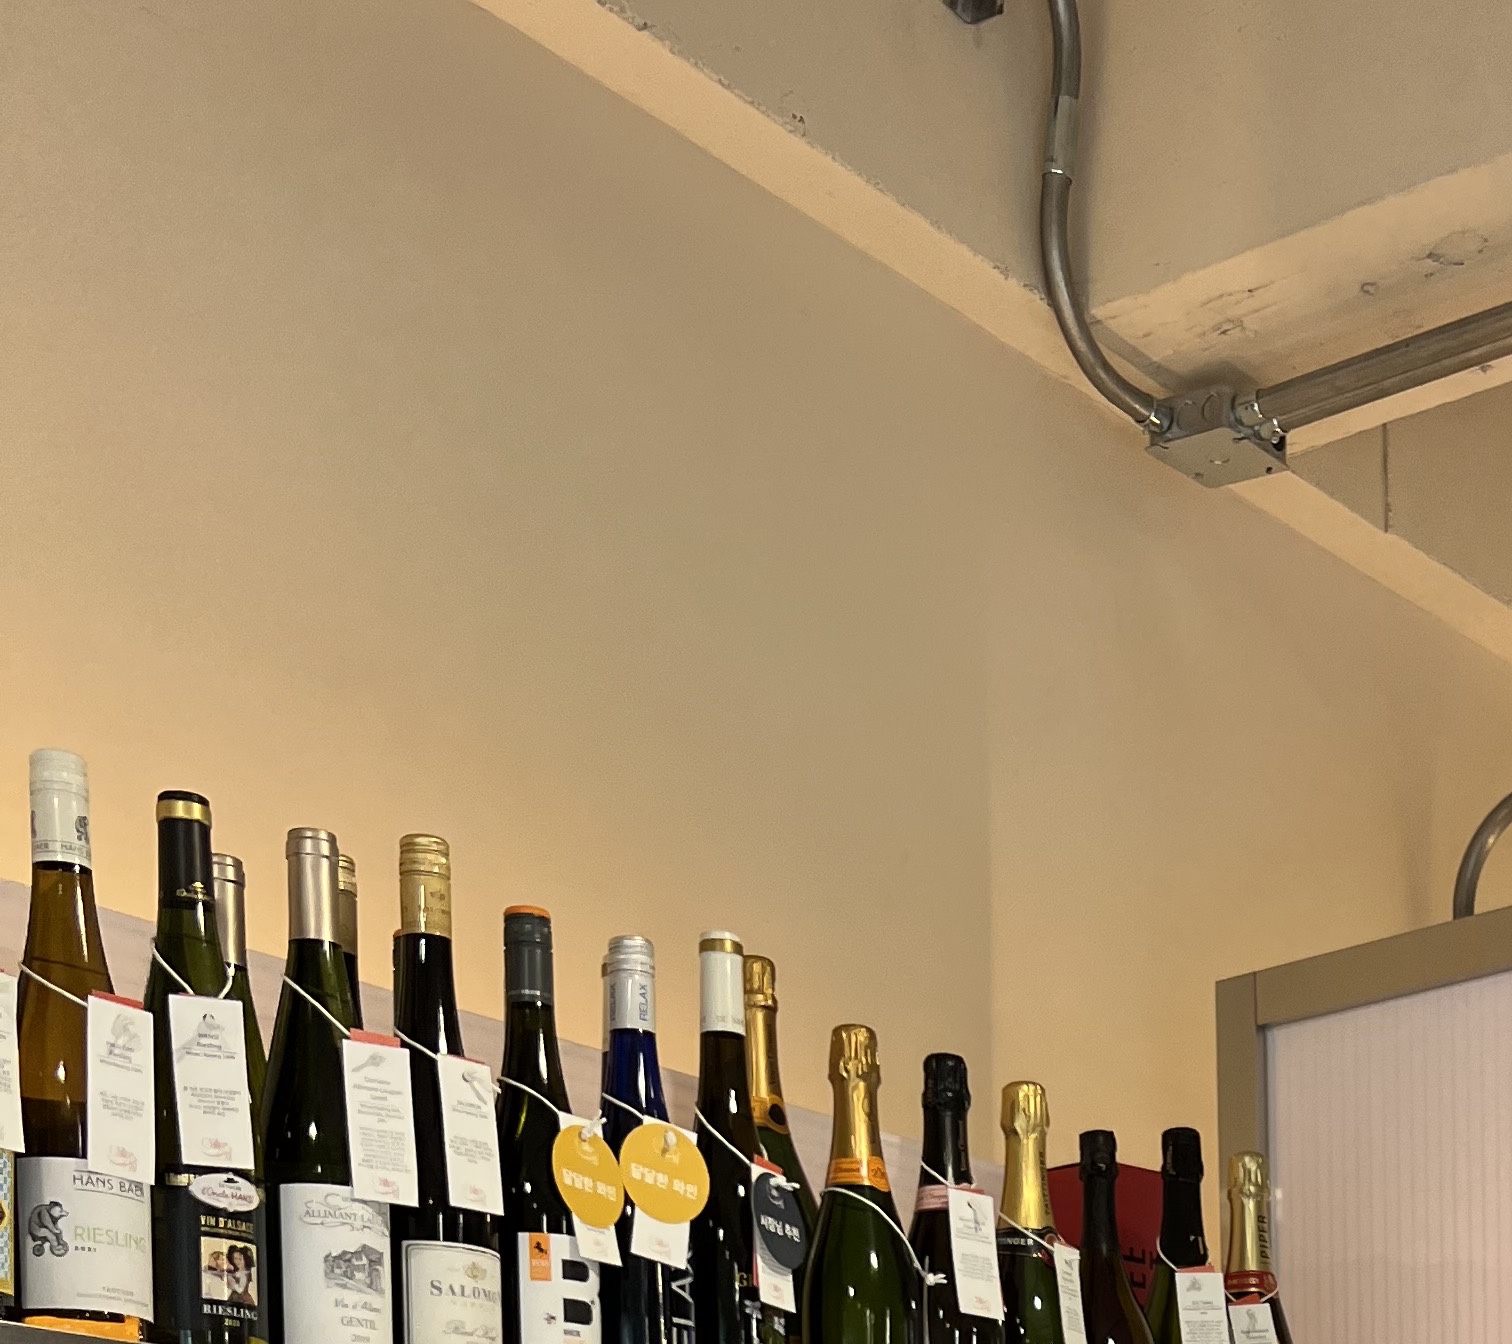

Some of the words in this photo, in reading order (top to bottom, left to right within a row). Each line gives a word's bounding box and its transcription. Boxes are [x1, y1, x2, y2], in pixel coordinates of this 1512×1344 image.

[638, 982, 648, 1023] RELAX
[73, 1174, 114, 1191] HANS
[630, 1162, 669, 1188] 달달한
[73, 1225, 148, 1253] RIESLING
[203, 1304, 259, 1320] RIESLING
